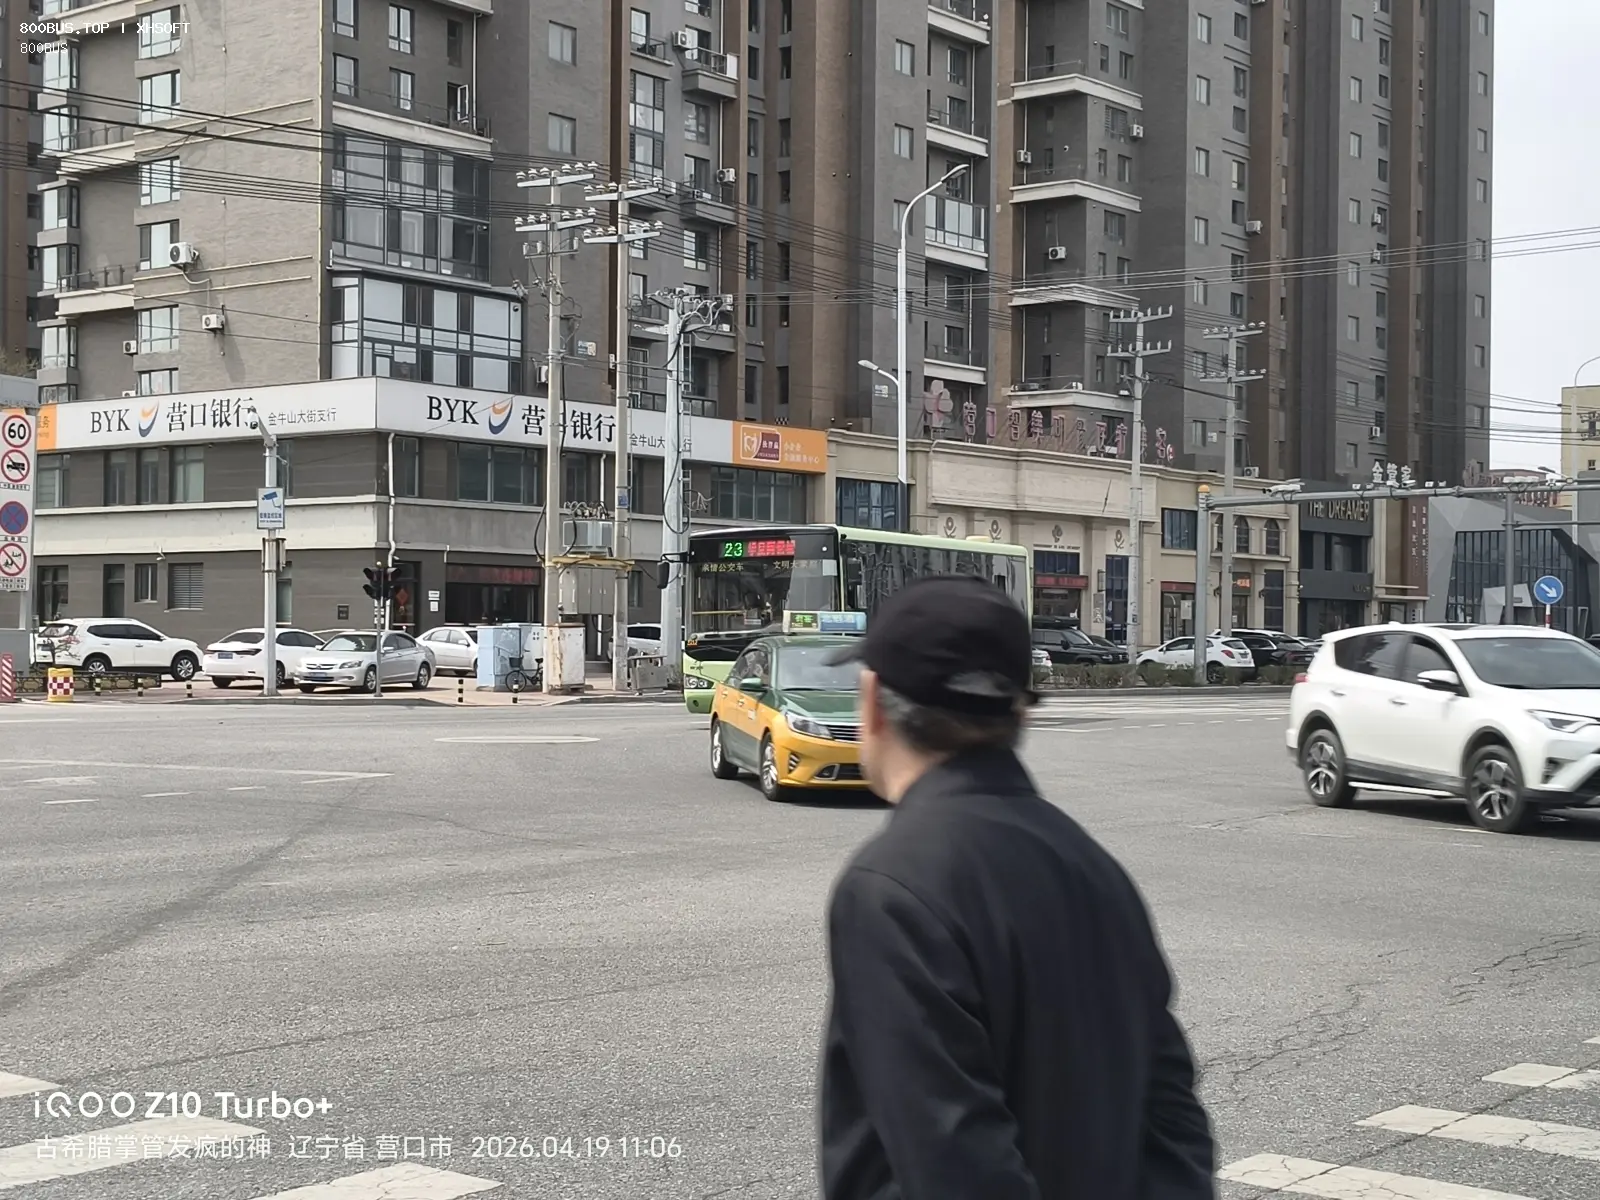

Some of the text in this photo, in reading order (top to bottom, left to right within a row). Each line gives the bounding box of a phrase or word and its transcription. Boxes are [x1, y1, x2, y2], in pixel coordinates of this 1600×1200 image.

[90, 397, 338, 434] BYK 营口银行 金牛山大街支行
[426, 395, 693, 451] BYK 营银行 金牛山大行
[7, 422, 27, 441] 60
[1307, 500, 1371, 522] THE DREAMER
[723, 542, 744, 557] 23
